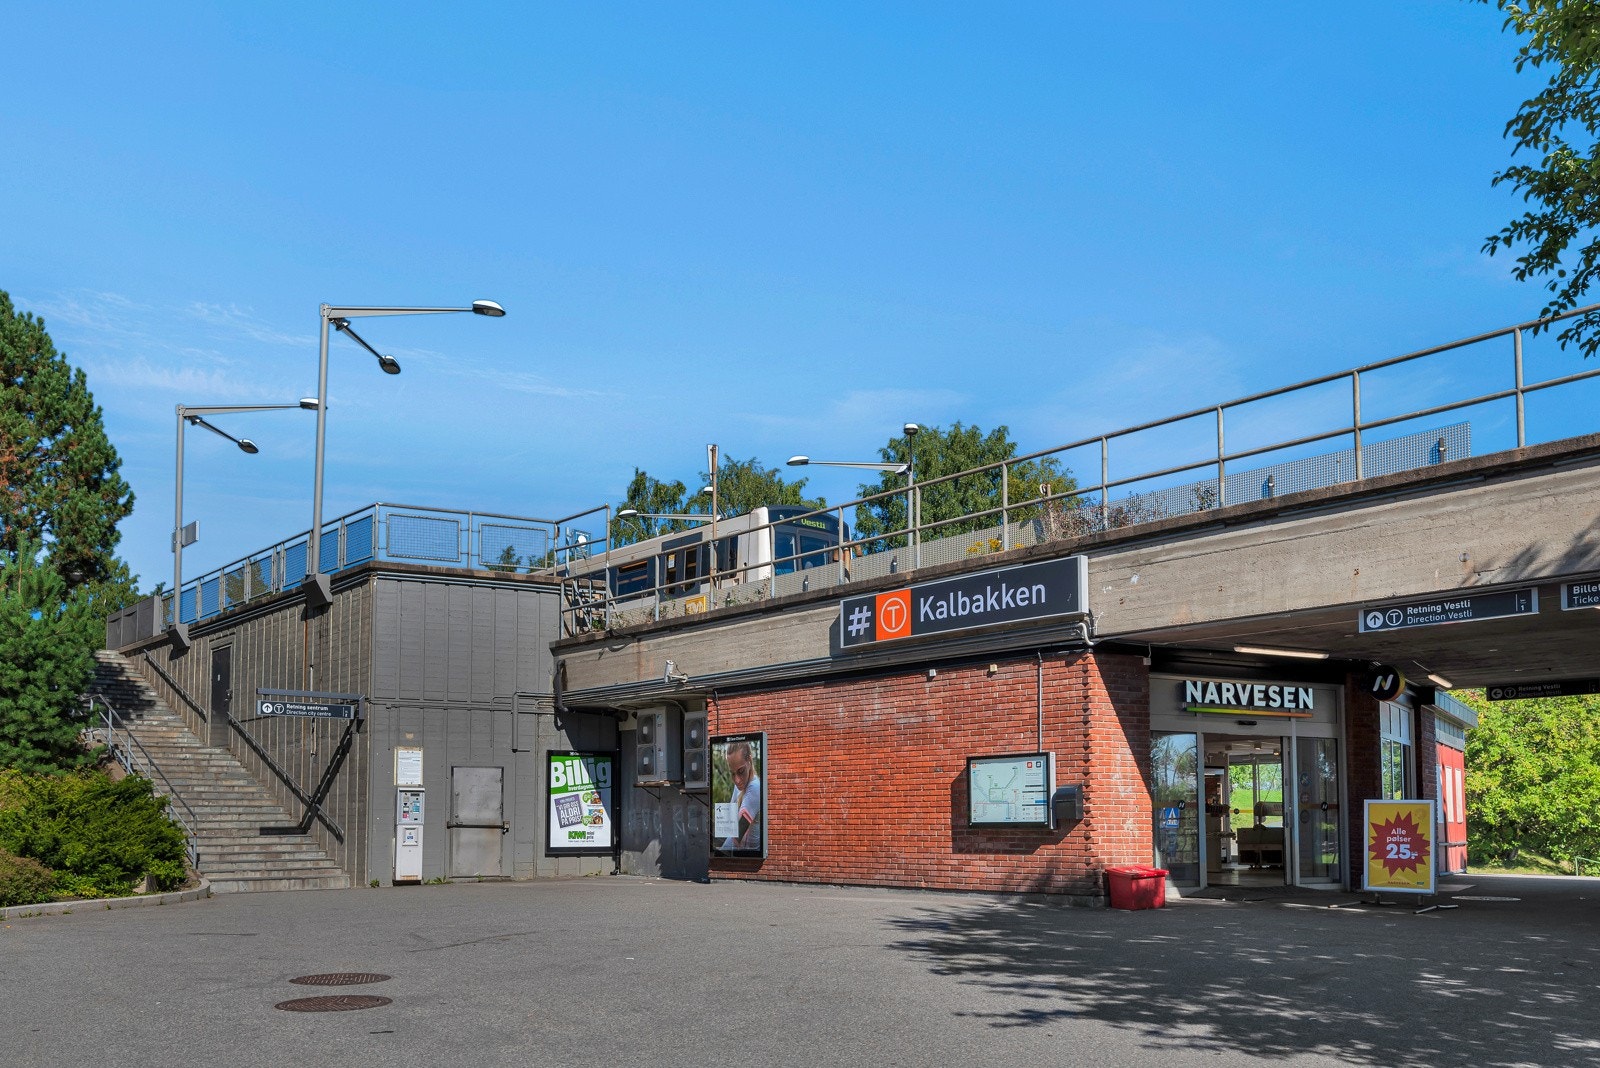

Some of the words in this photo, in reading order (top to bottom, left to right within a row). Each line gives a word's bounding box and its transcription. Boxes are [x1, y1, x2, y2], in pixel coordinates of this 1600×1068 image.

[920, 583, 1046, 622] Kalbakken
[1407, 604, 1441, 615] Retning
[1444, 600, 1471, 610] Vestli
[1408, 613, 1446, 624] Direction
[1448, 610, 1472, 619] Vestli
[1186, 680, 1314, 710] NARVESEN
[551, 757, 611, 788] Billig
[568, 831, 586, 839] KIWI
